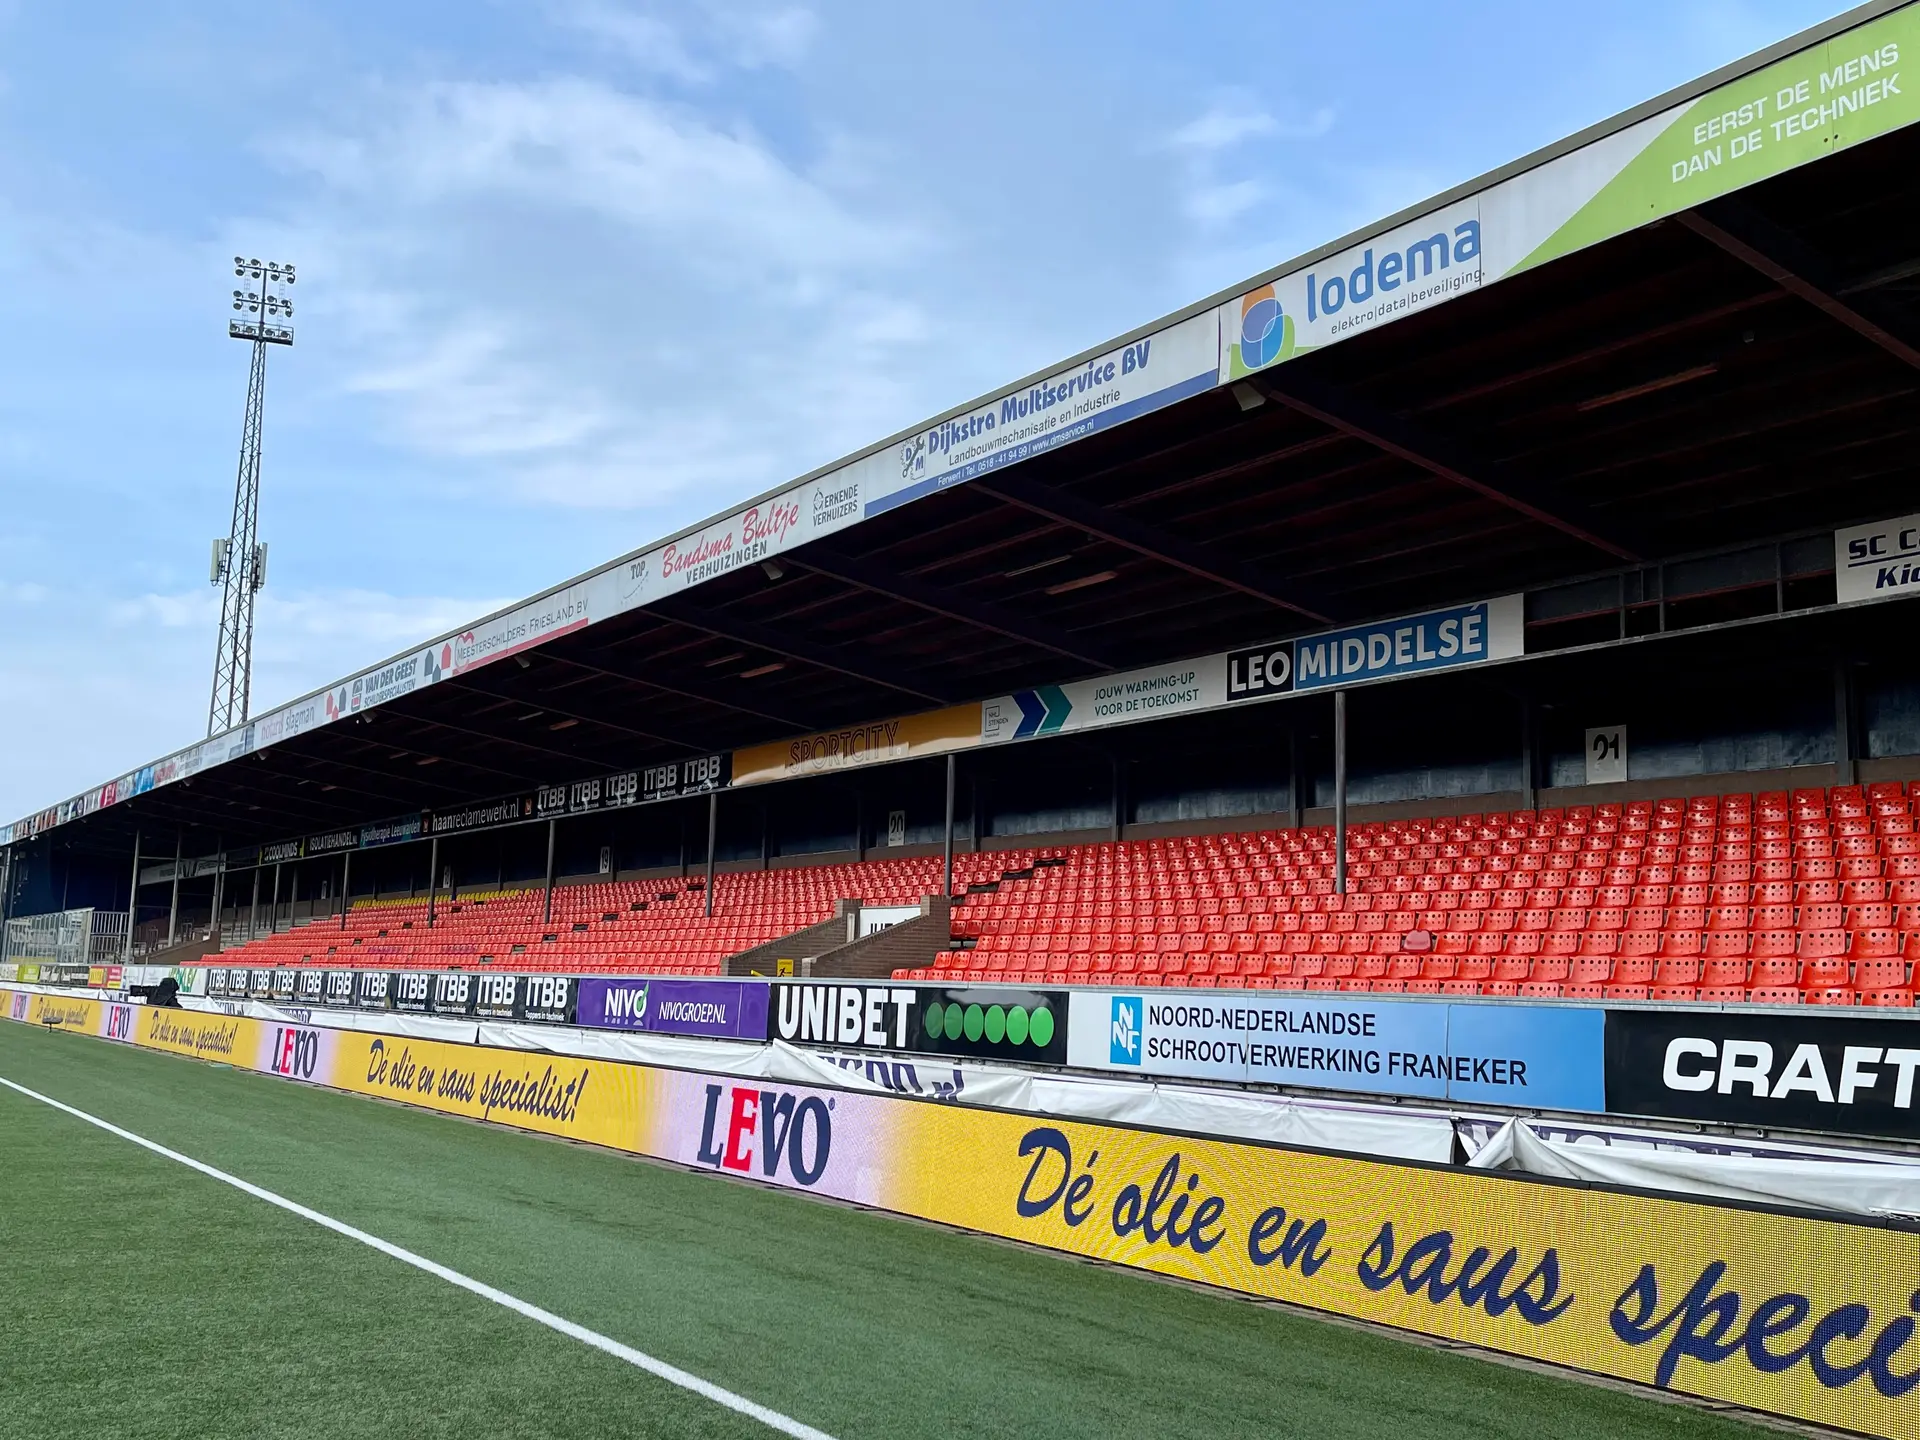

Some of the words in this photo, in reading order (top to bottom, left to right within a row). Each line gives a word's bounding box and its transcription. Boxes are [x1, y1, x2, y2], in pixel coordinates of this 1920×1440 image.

[1693, 101, 1767, 145] EERST
[1776, 80, 1810, 111] DE
[1819, 44, 1899, 95] MENS
[1671, 152, 1721, 184] DAN
[1730, 131, 1763, 161] DE
[1770, 74, 1901, 143] TECHNIEK
[1306, 218, 1480, 323] lodema
[928, 412, 996, 455] Dijkstra
[1001, 361, 1115, 425] Multiservice
[1122, 340, 1151, 375] BV
[949, 415, 1057, 466] Landbouwmechanisatie
[1060, 411, 1072, 423] en
[1074, 389, 1121, 418] Industrie
[978, 459, 993, 472] 0518
[824, 484, 859, 509] ERKENDE
[812, 500, 858, 527] VERHUIZERS
[662, 532, 734, 578] Bandsma
[742, 501, 799, 544] Bultje
[1849, 534, 1886, 560] SC
[1900, 528, 1920, 550] C
[631, 560, 646, 580] TOP
[686, 540, 767, 584] VERHUIZINGEN
[457, 624, 526, 660] MEESTERSCHILDERS
[529, 605, 574, 633] FRIESLAND
[577, 598, 589, 614] BV
[1231, 651, 1290, 692] LEO
[1299, 603, 1483, 682] MIDDELSÉ
[365, 676, 379, 694] VAN
[380, 670, 393, 688] DER
[395, 657, 418, 681] GEEST
[1094, 685, 1123, 701] JOUW
[1125, 671, 1195, 694] WARMING-UP
[1095, 702, 1123, 716] VOOR
[1126, 699, 1139, 711] DE
[1142, 688, 1199, 708] TOEKOMST
[789, 721, 900, 774] SPORTCITY
[606, 772, 638, 798] ITBB
[644, 765, 678, 791] ITBB
[684, 756, 720, 783] ITBB
[571, 779, 600, 803] ITBB
[432, 798, 519, 832] haanreclamewerk.nl
[209, 969, 226, 988] ITBB
[229, 970, 247, 989] ITBB
[250, 970, 269, 990] ITBB
[274, 971, 294, 992] ITBB
[300, 971, 321, 993] ITBB
[327, 972, 352, 995] ITBB
[361, 973, 388, 997] ITBB
[397, 973, 428, 1000] ITBB
[435, 975, 469, 1002] ITBB
[477, 975, 516, 1005] ITBB
[526, 977, 568, 1008] ITBB
[476, 1007, 492, 1016] Toppers
[496, 1009, 513, 1017] techniek
[525, 1010, 541, 1020] Toppers
[546, 1012, 565, 1022] techniek
[604, 987, 648, 1019] NIVO
[659, 1001, 727, 1024] NIVOGROEP.NL
[778, 985, 917, 1048] UNIBET
[107, 1005, 130, 1039] LEVO
[1148, 1004, 1376, 1036] NOORD-NEDERLANDSE
[271, 1027, 318, 1078] LEVO
[1147, 1038, 1380, 1075] SCHROOTVERWERKING
[1388, 1052, 1528, 1087] FRANEKER
[367, 1038, 389, 1085] Dé
[389, 1046, 416, 1090] olie
[417, 1065, 434, 1091] en
[438, 1068, 476, 1104] saus
[480, 1065, 589, 1122] specialist!
[1662, 1037, 1920, 1109] CRAFT
[697, 1083, 832, 1186] LEVO
[1018, 1127, 1097, 1226] Dé
[1112, 1152, 1227, 1254] olie
[1248, 1205, 1332, 1277] en
[1357, 1220, 1575, 1325] saus
